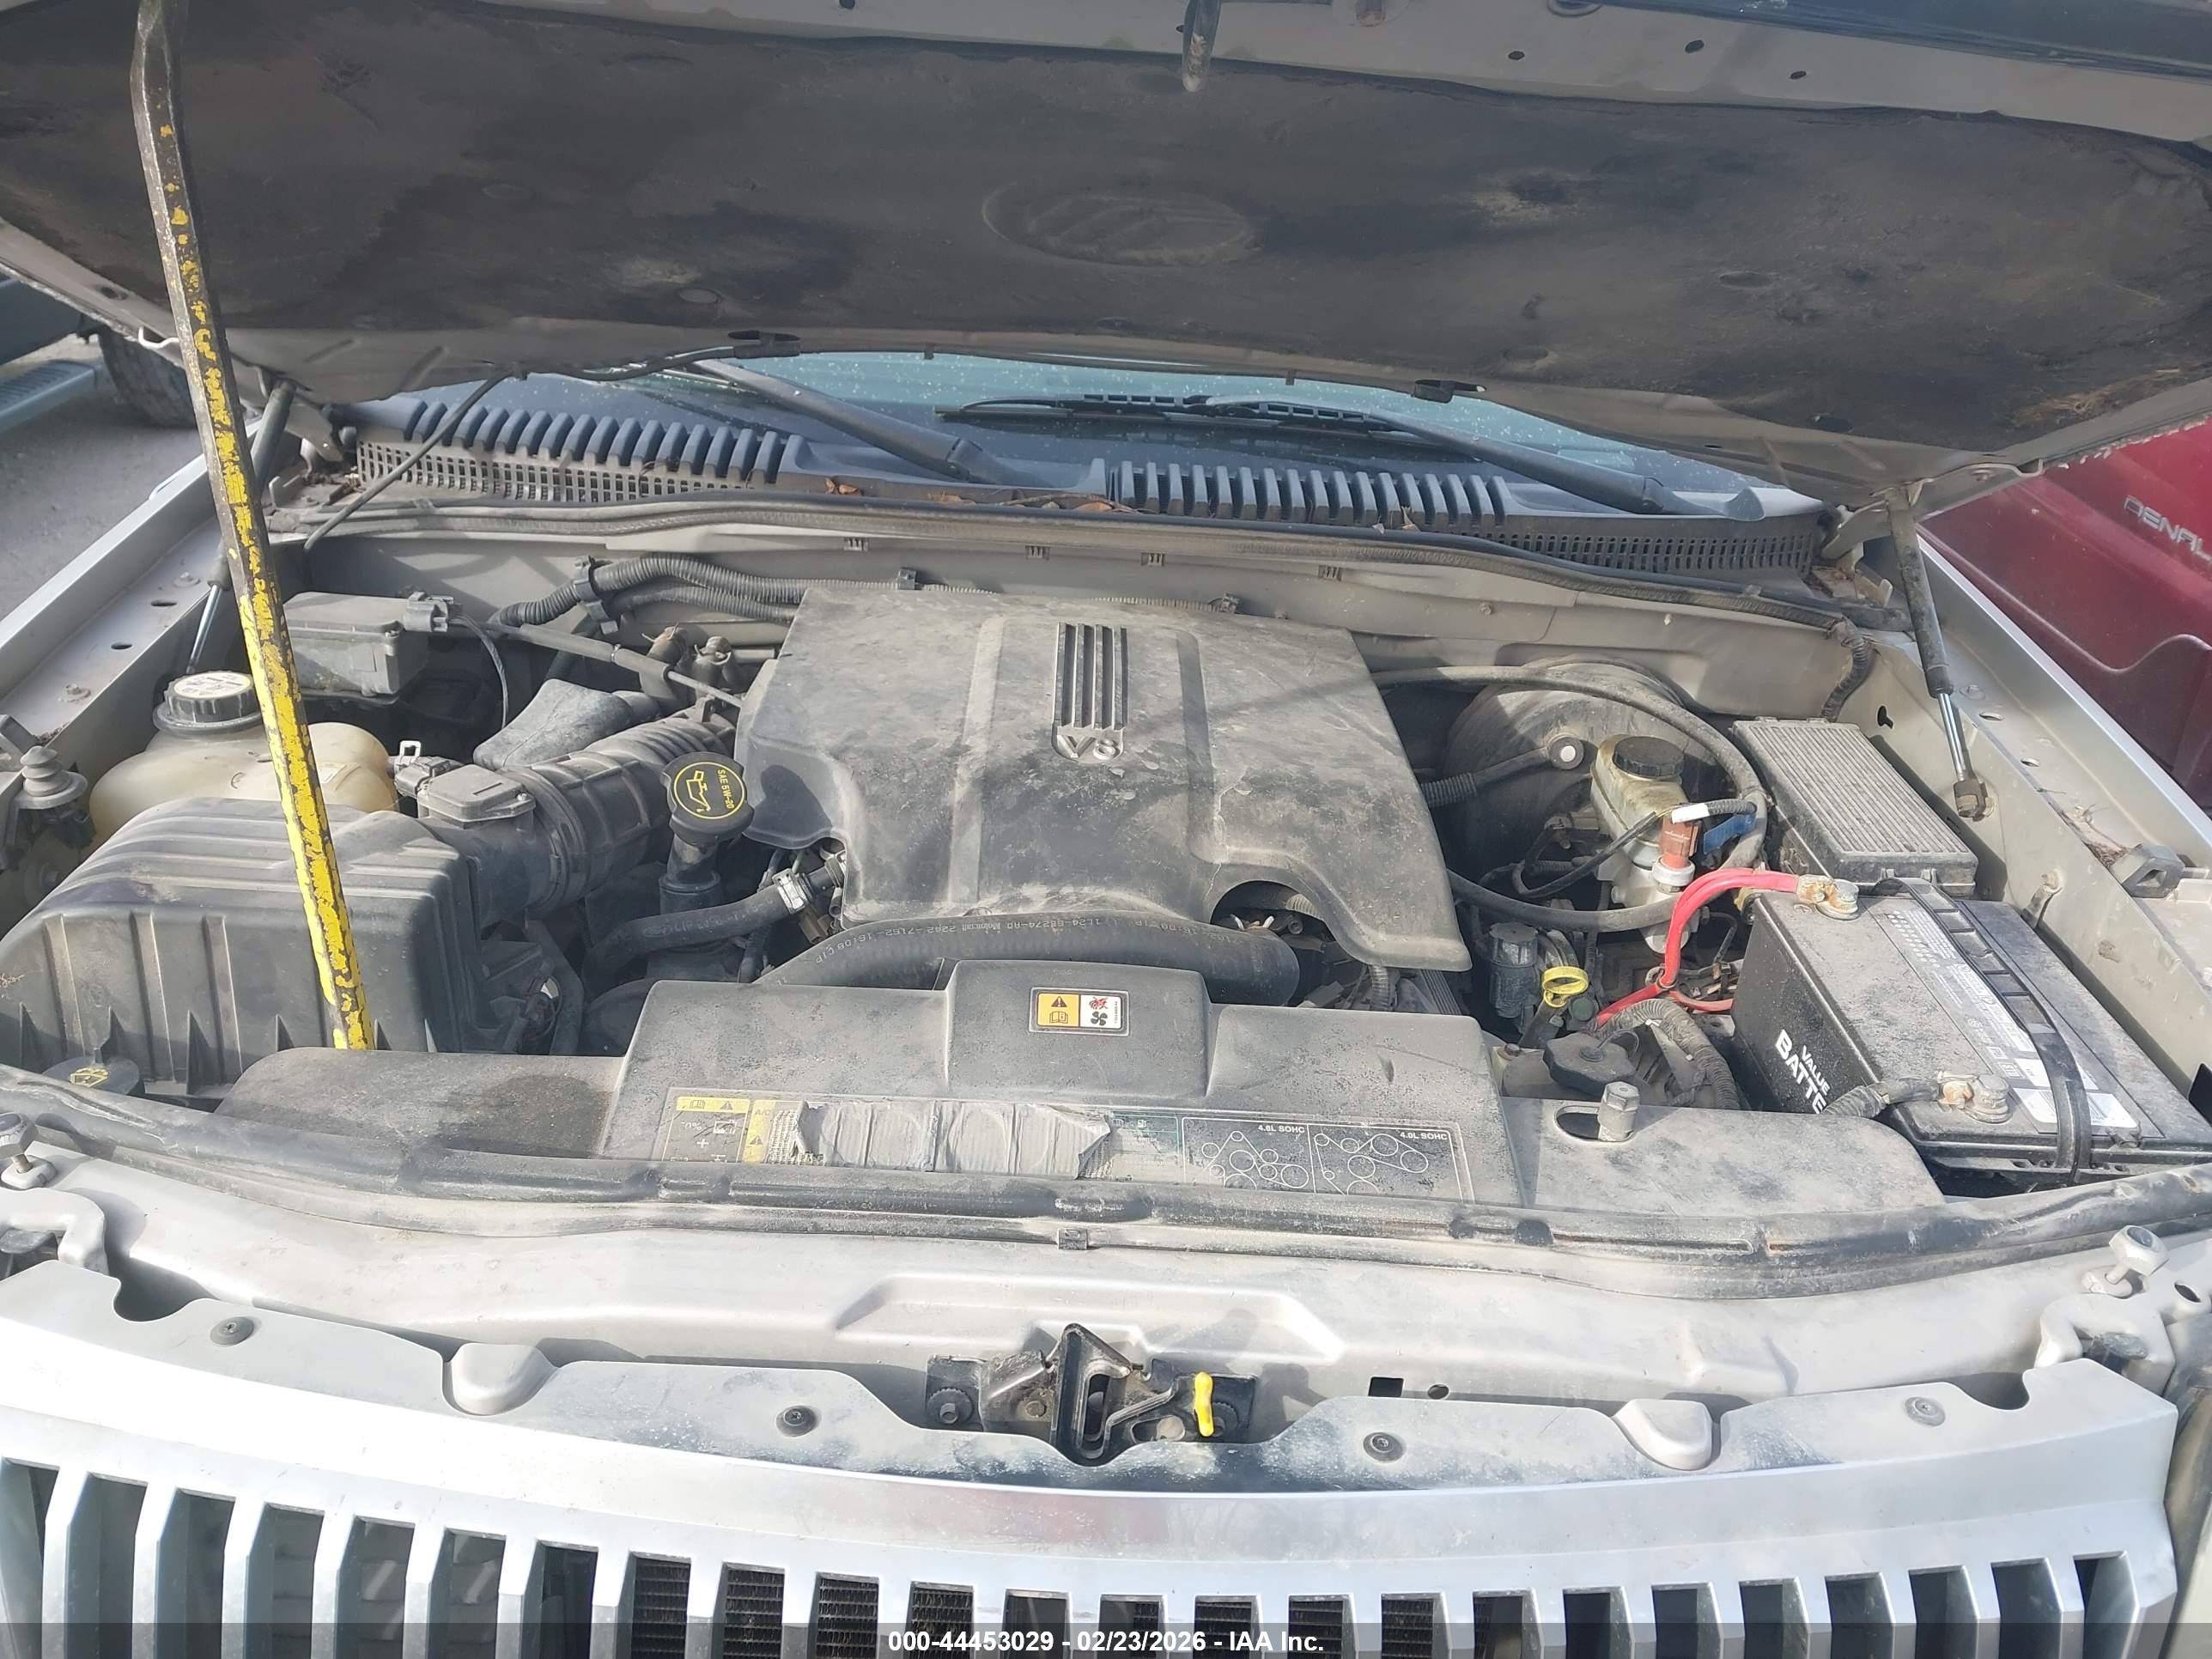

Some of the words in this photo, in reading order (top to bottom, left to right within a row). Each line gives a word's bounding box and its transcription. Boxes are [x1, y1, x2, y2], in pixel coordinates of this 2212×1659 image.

[1057, 735, 1117, 761] V8
[717, 769, 728, 784] SAE
[721, 785, 735, 809] 5W-20
[1802, 1045, 1831, 1096] VALUE
